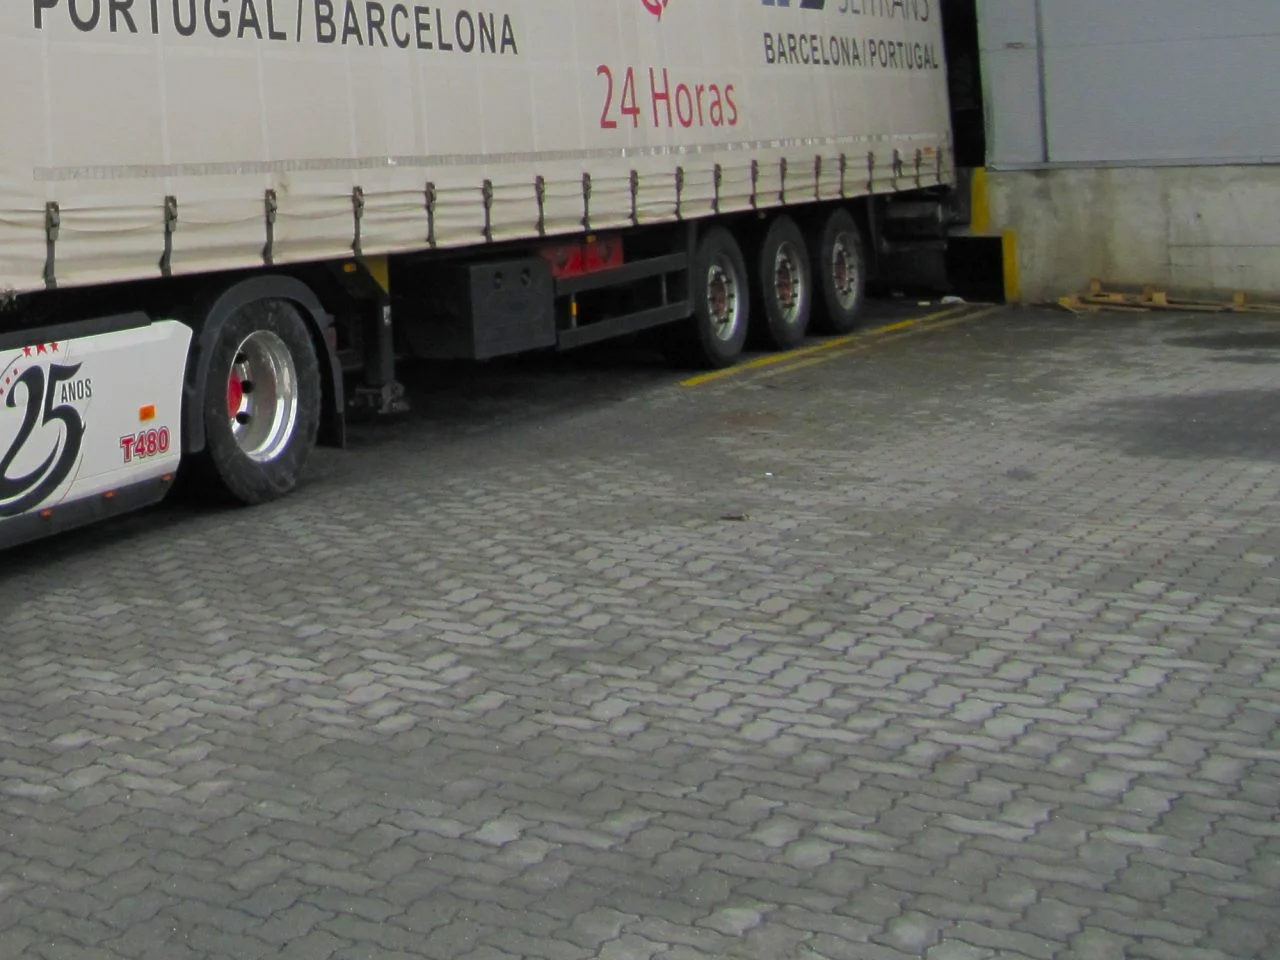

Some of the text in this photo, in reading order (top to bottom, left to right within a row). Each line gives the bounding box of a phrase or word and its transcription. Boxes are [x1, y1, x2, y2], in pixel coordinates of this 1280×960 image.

[597, 64, 739, 130] 24 Horas
[60, 379, 93, 403] ANOS
[120, 426, 170, 463] T480
